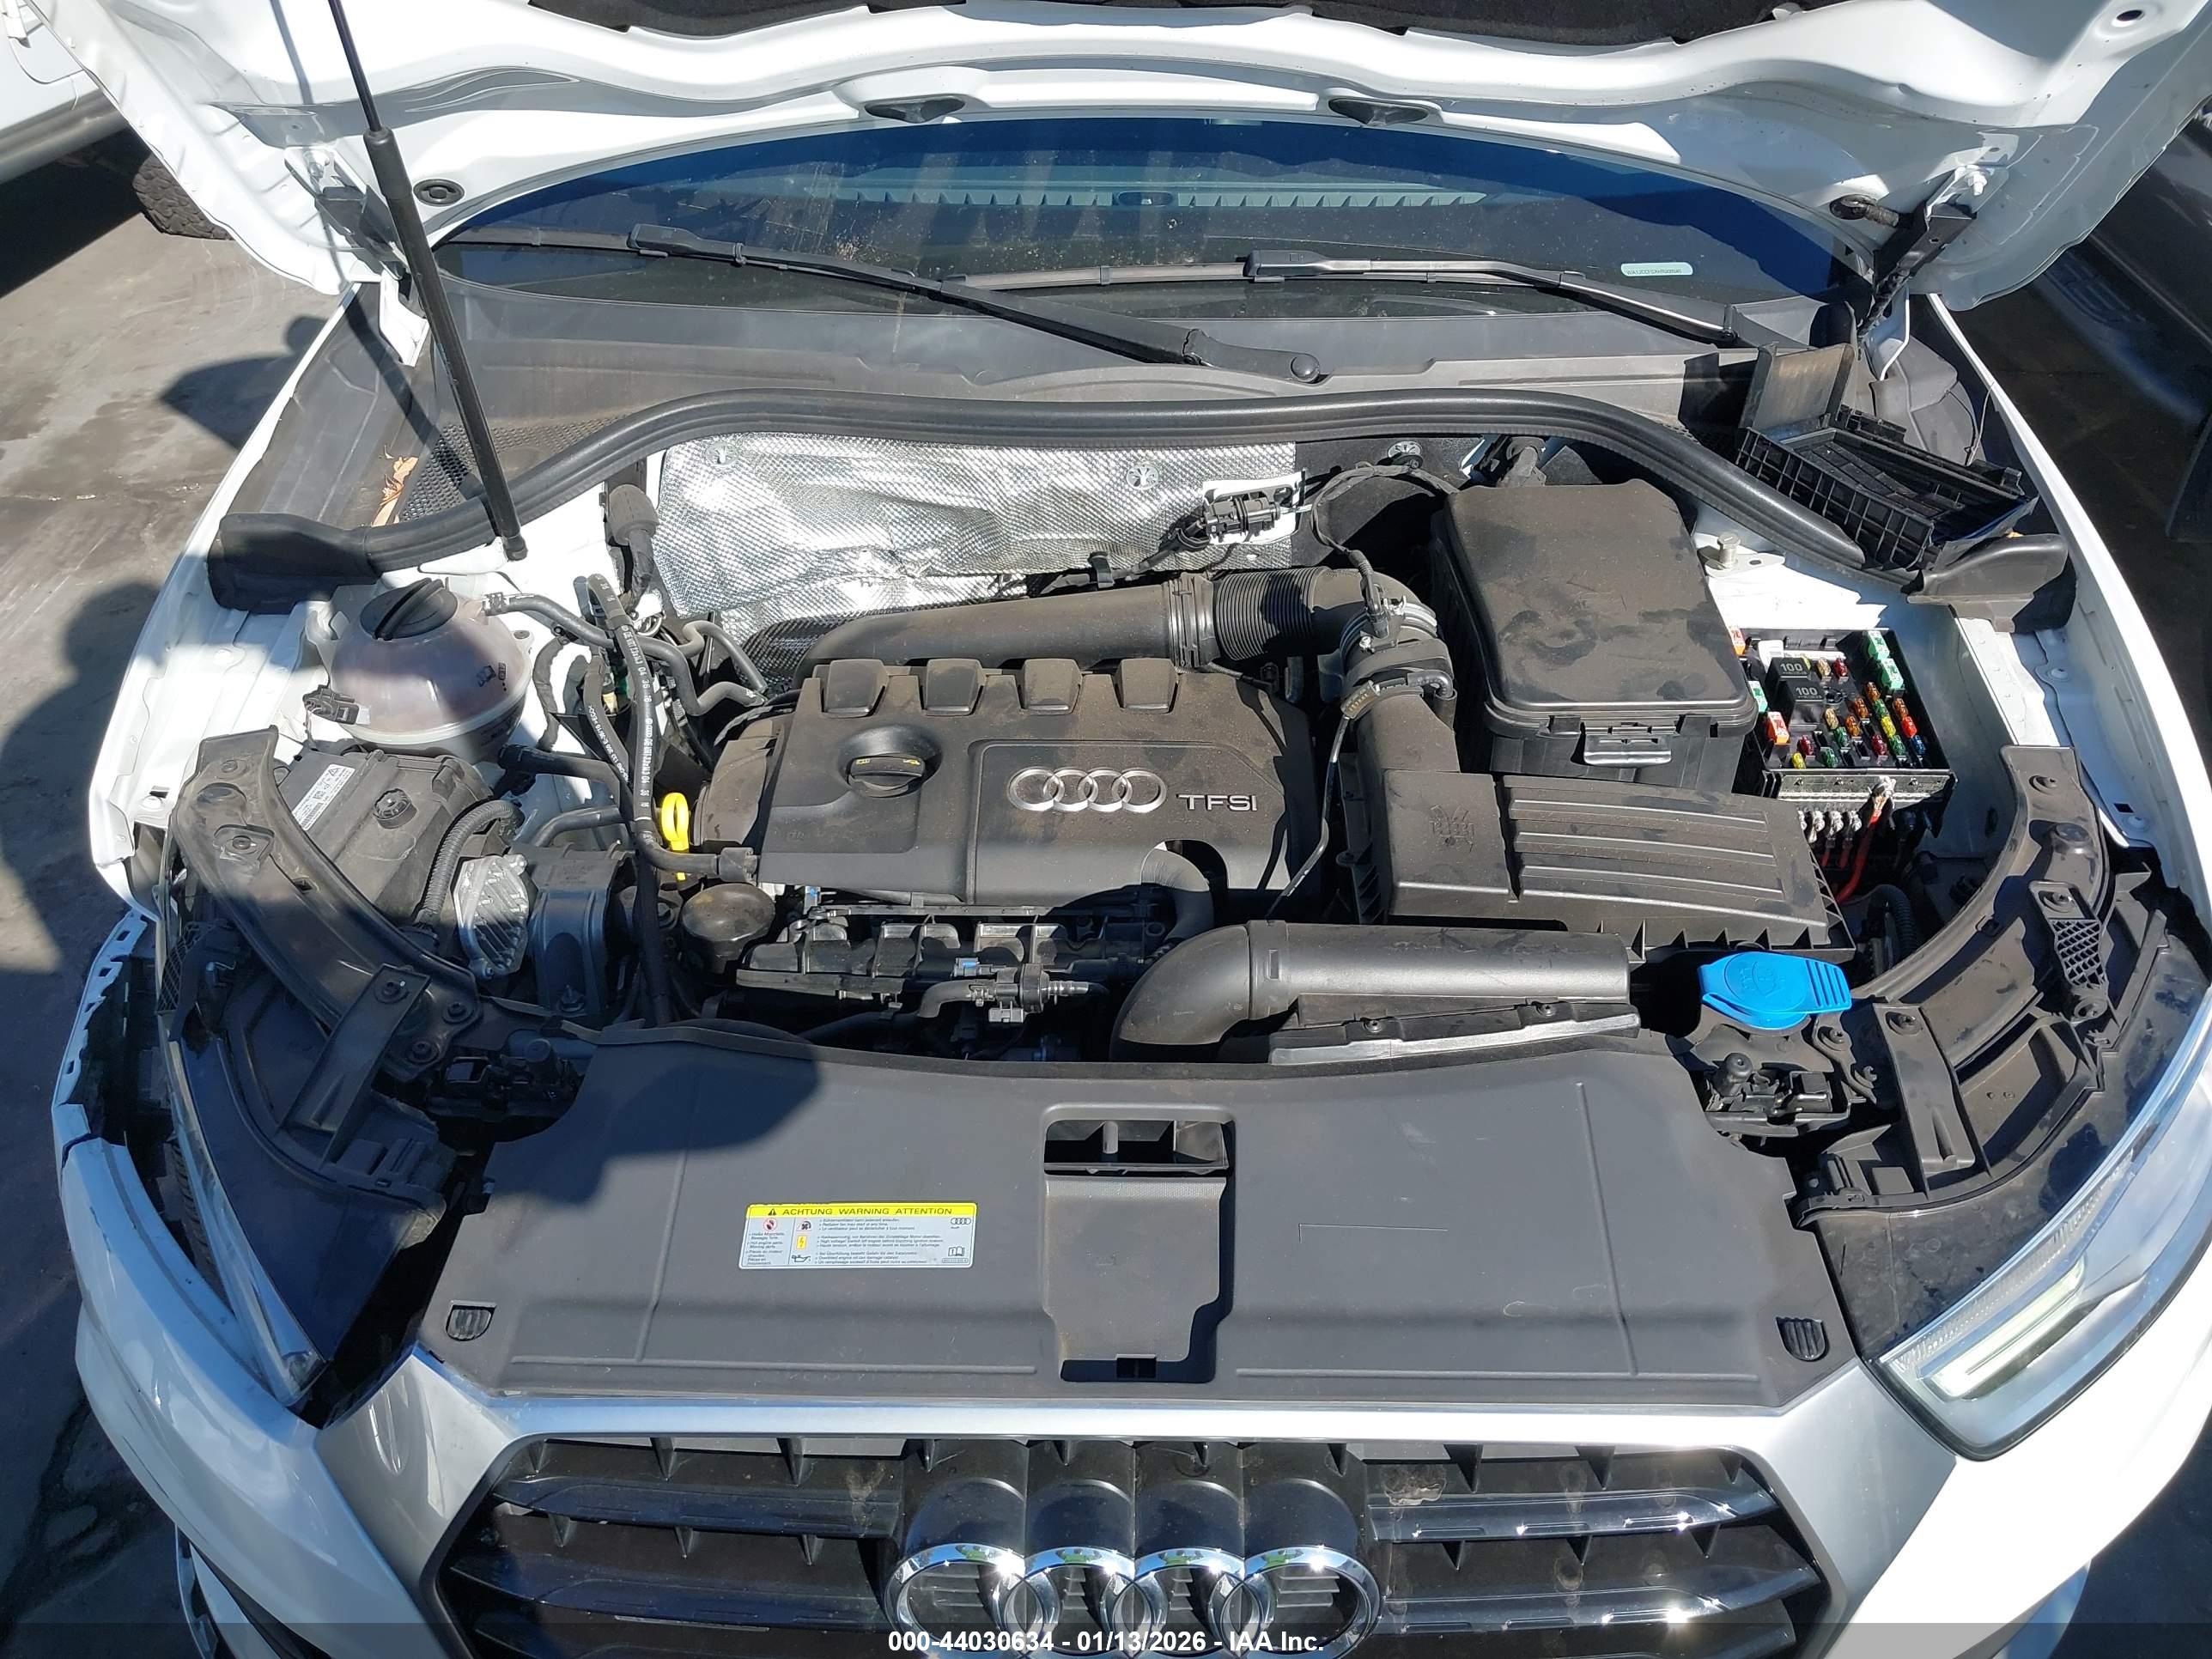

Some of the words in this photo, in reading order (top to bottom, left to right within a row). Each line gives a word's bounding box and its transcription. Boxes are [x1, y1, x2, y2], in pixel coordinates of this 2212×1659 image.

[1780, 663, 1803, 672] 100
[1796, 687, 1818, 696] 100
[1177, 794, 1258, 811] TFSI
[782, 1207, 833, 1216] ACHTUNG
[895, 1206, 952, 1215] ATTENTION
